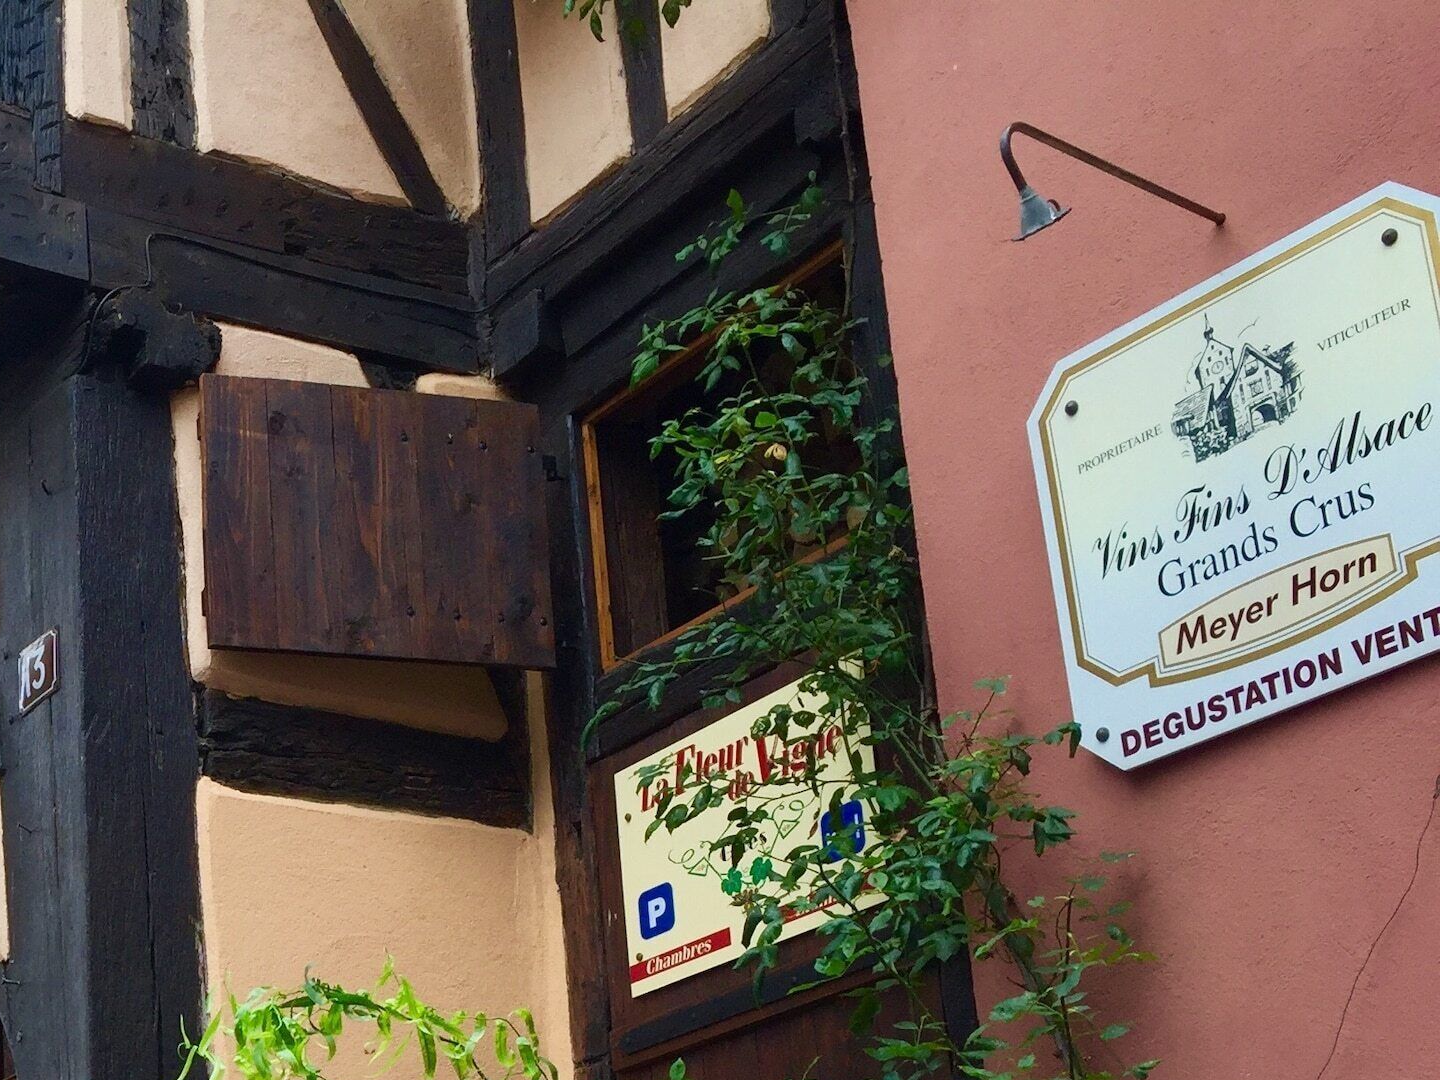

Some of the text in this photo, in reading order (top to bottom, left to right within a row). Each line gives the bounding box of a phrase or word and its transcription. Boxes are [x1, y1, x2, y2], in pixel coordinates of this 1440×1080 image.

[1078, 298, 1411, 474] PROPRIETAIRE VITICULTEUR
[1092, 402, 1433, 580] Vins Fins D'Alsace
[1158, 482, 1375, 597] Grands Crus
[1176, 549, 1378, 655] Meyer Horn
[1121, 646, 1343, 758] DEGUSTATION
[673, 735, 749, 797] Fleur
[646, 939, 713, 975] Chambres
[647, 896, 667, 929] P
